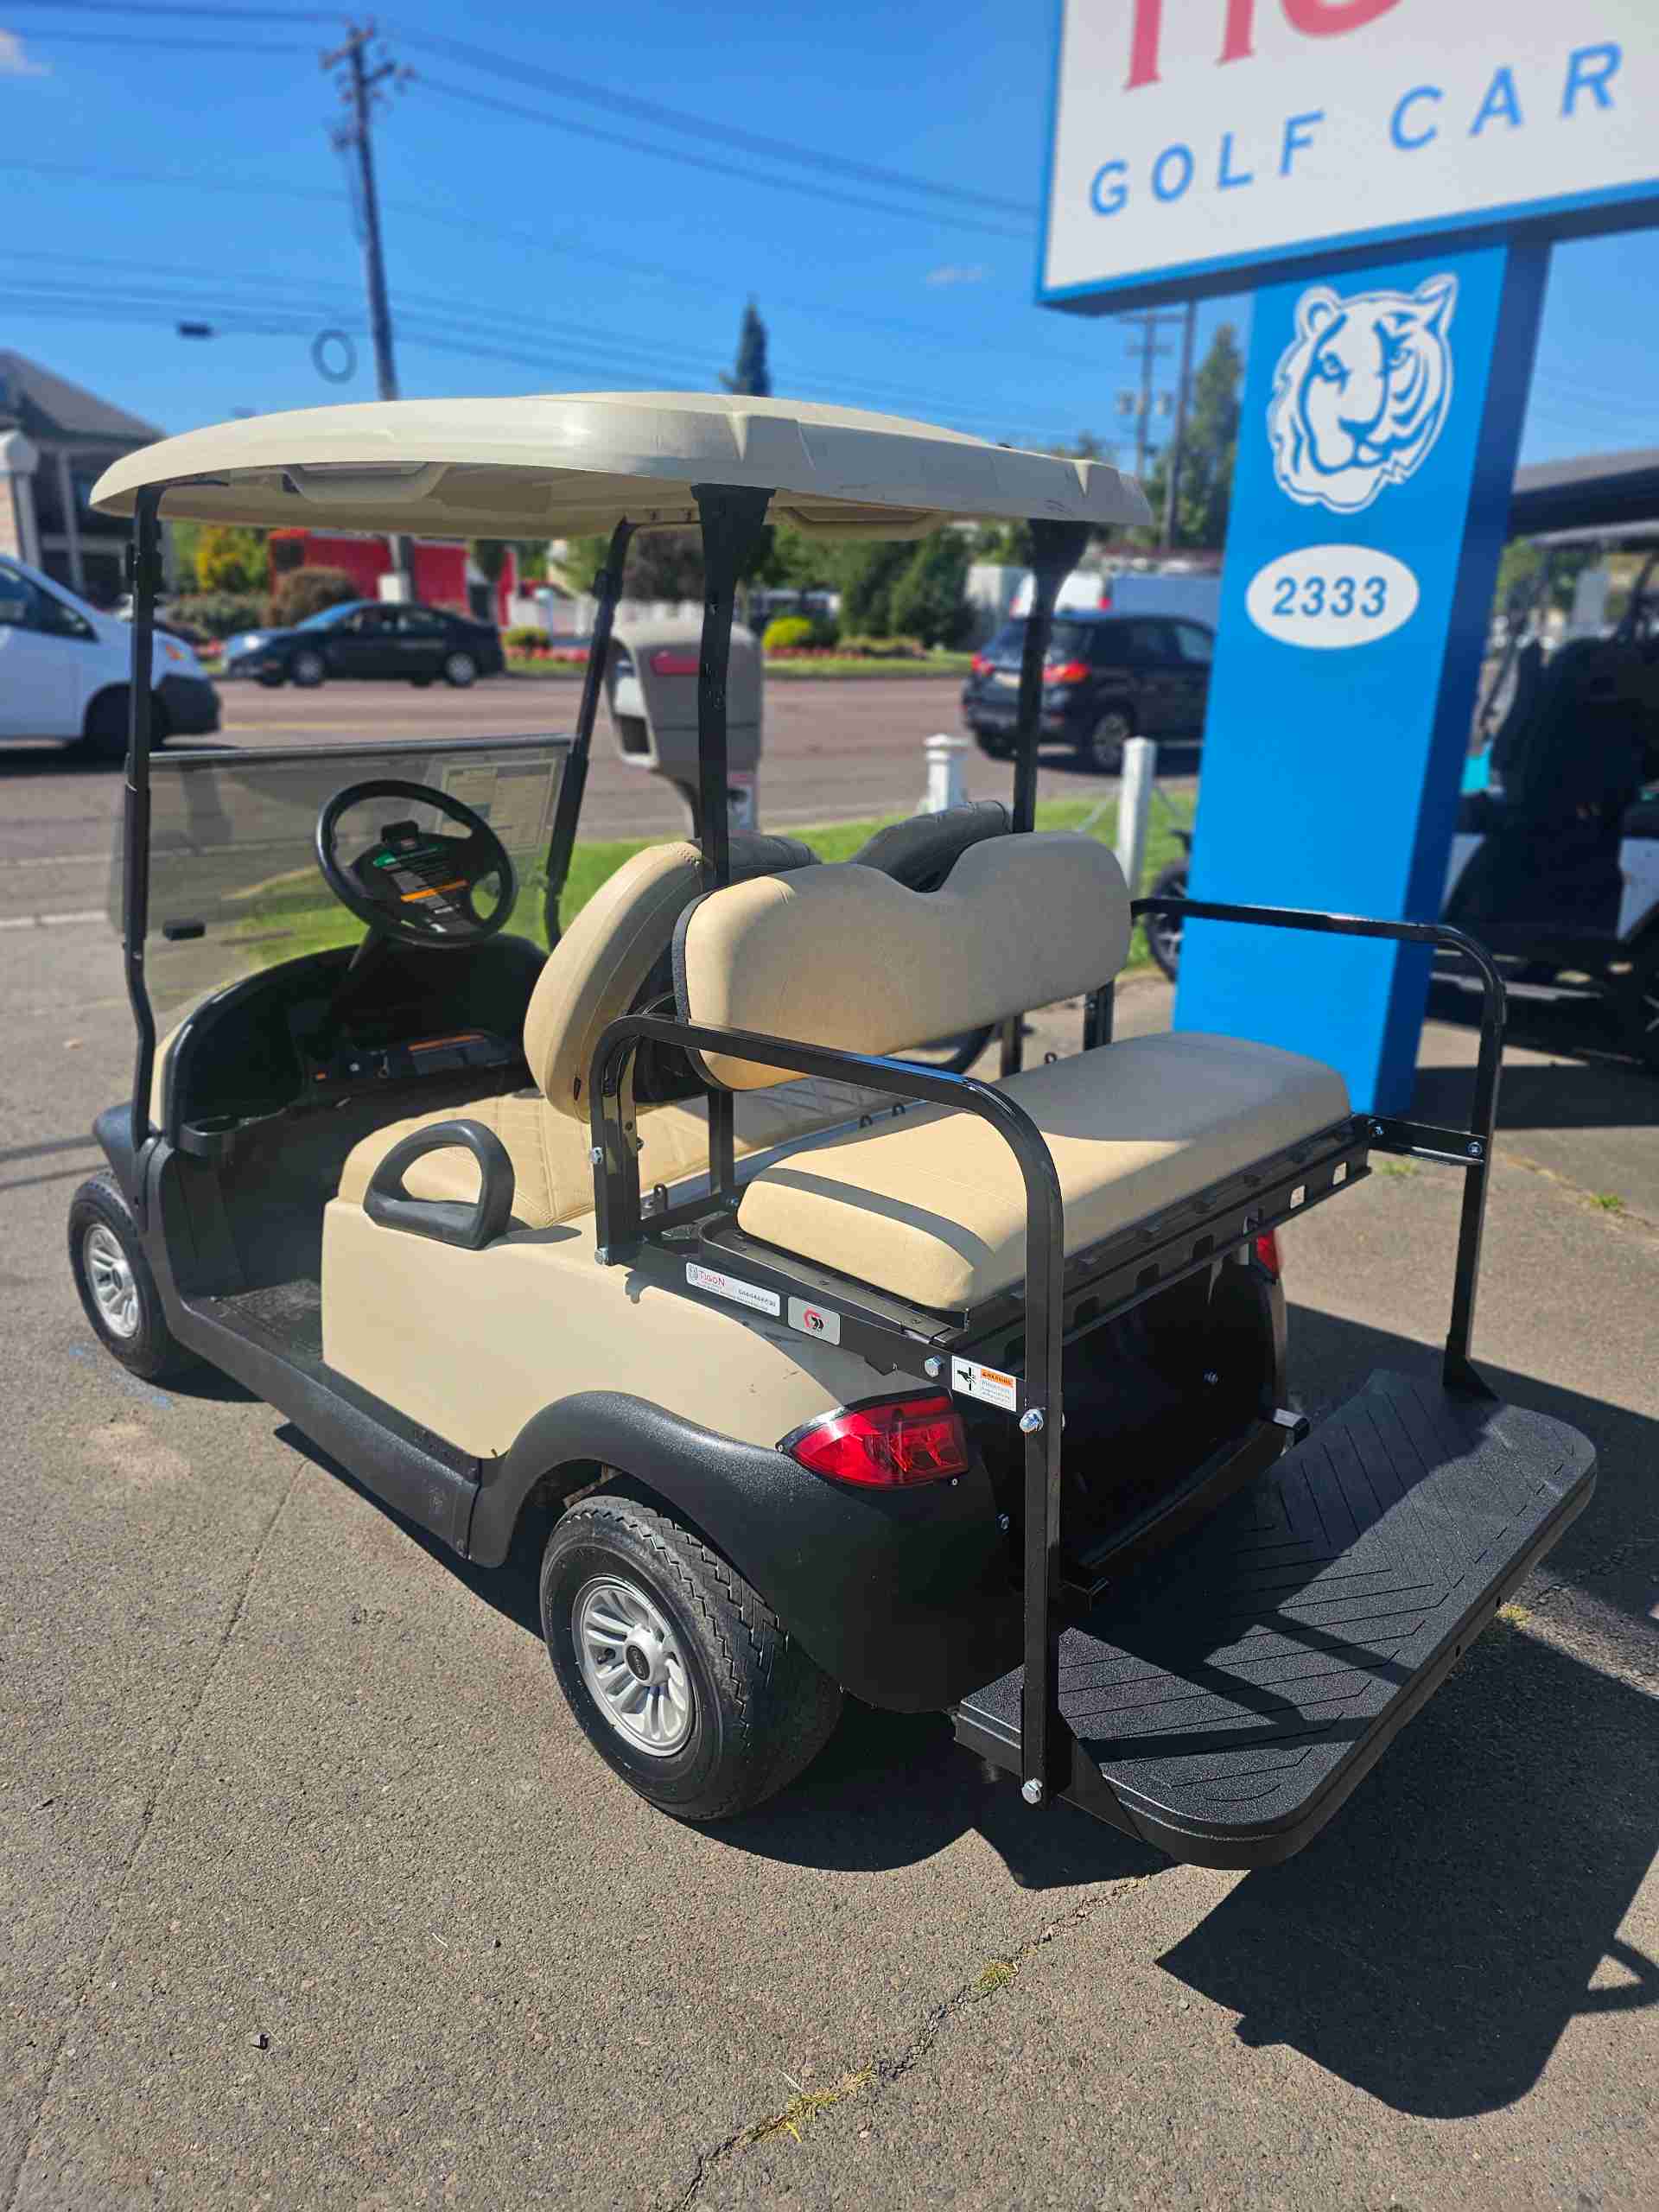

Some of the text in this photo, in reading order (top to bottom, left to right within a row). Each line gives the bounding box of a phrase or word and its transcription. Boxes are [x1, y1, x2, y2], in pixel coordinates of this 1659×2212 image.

[1089, 110, 1326, 217] GOLF
[1389, 41, 1623, 151] CAR
[1272, 575, 1387, 618] 2333
